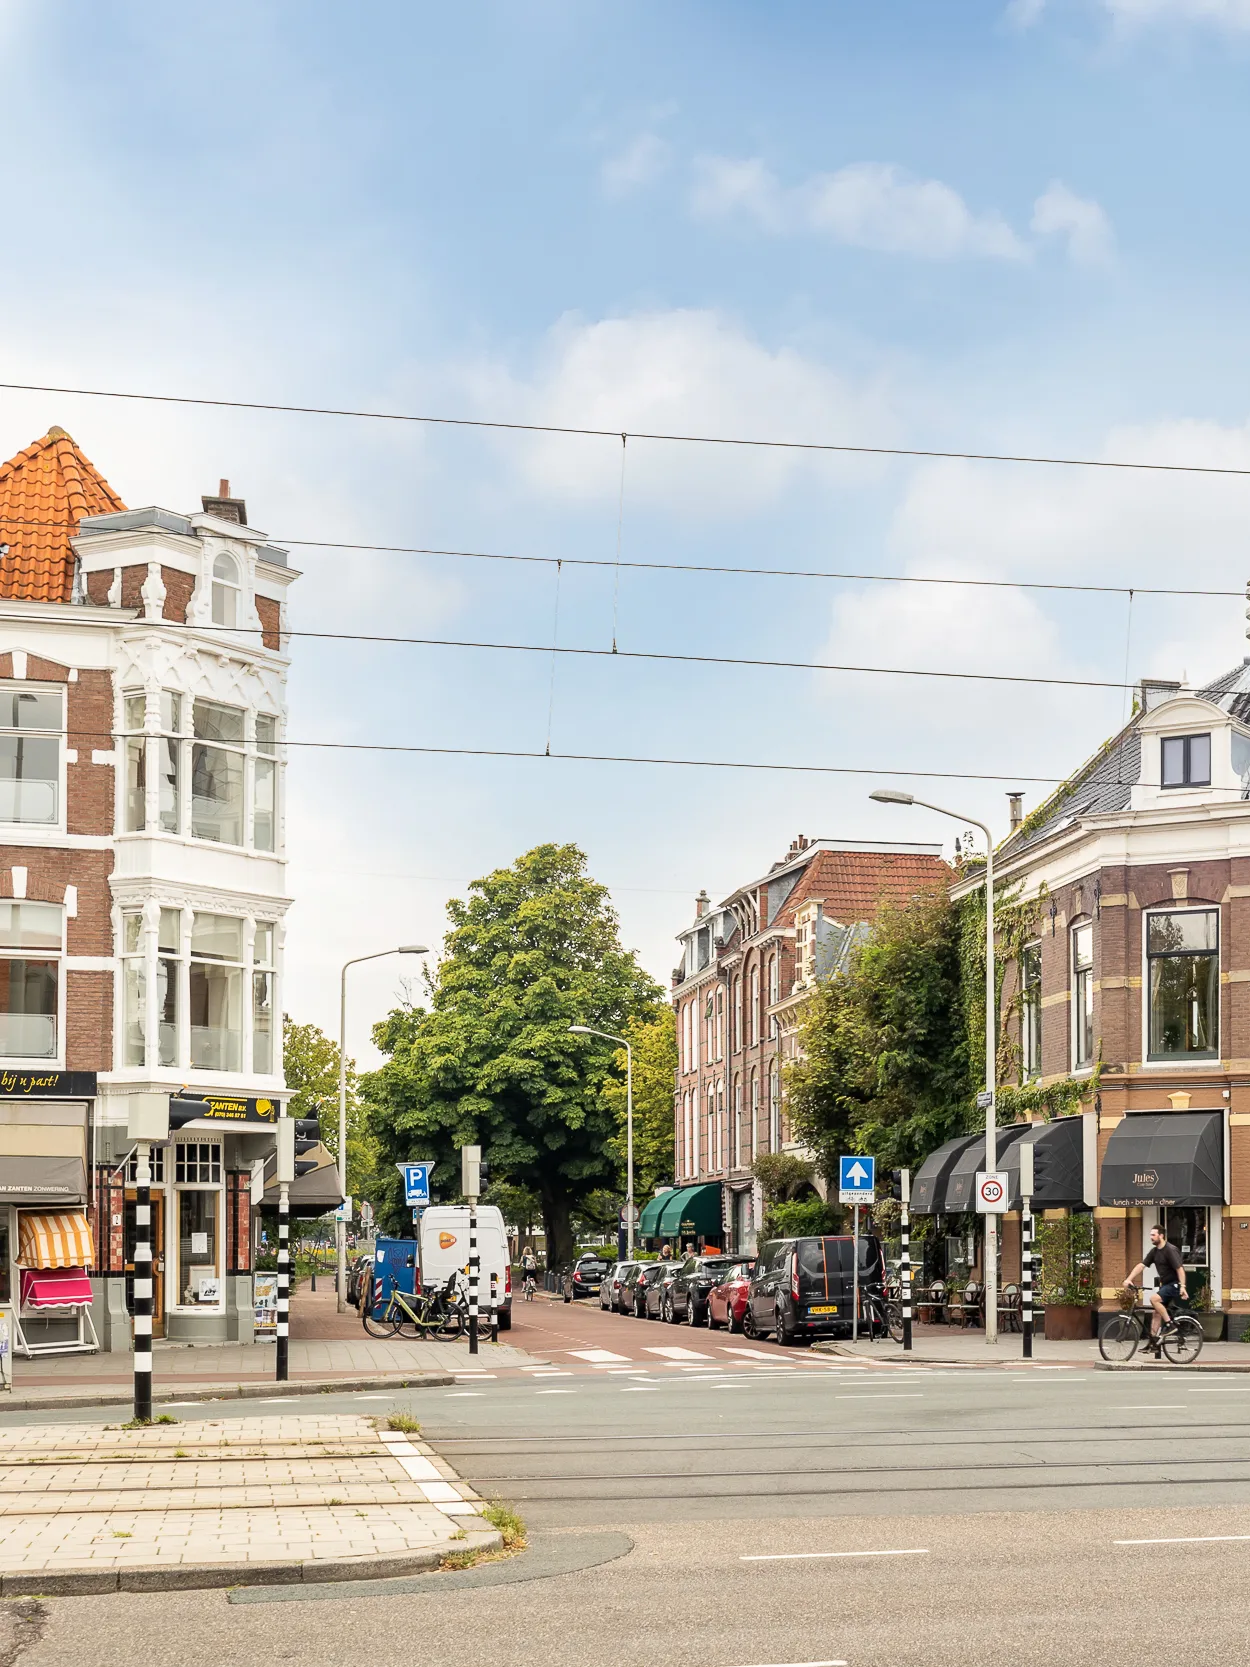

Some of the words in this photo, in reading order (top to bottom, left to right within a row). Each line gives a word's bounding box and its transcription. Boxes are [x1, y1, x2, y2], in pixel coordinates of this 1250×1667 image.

[1, 1071, 18, 1092] bij
[20, 1077, 27, 1086] u
[24, 1075, 59, 1093] past!
[210, 1101, 239, 1112] ZANTEN
[410, 1168, 423, 1187] P
[1132, 1173, 1155, 1184] Jules
[985, 1187, 999, 1196] 30
[1113, 1198, 1130, 1206] lunch
[1135, 1198, 1154, 1206] borrel
[115, 1215, 119, 1225] 2
